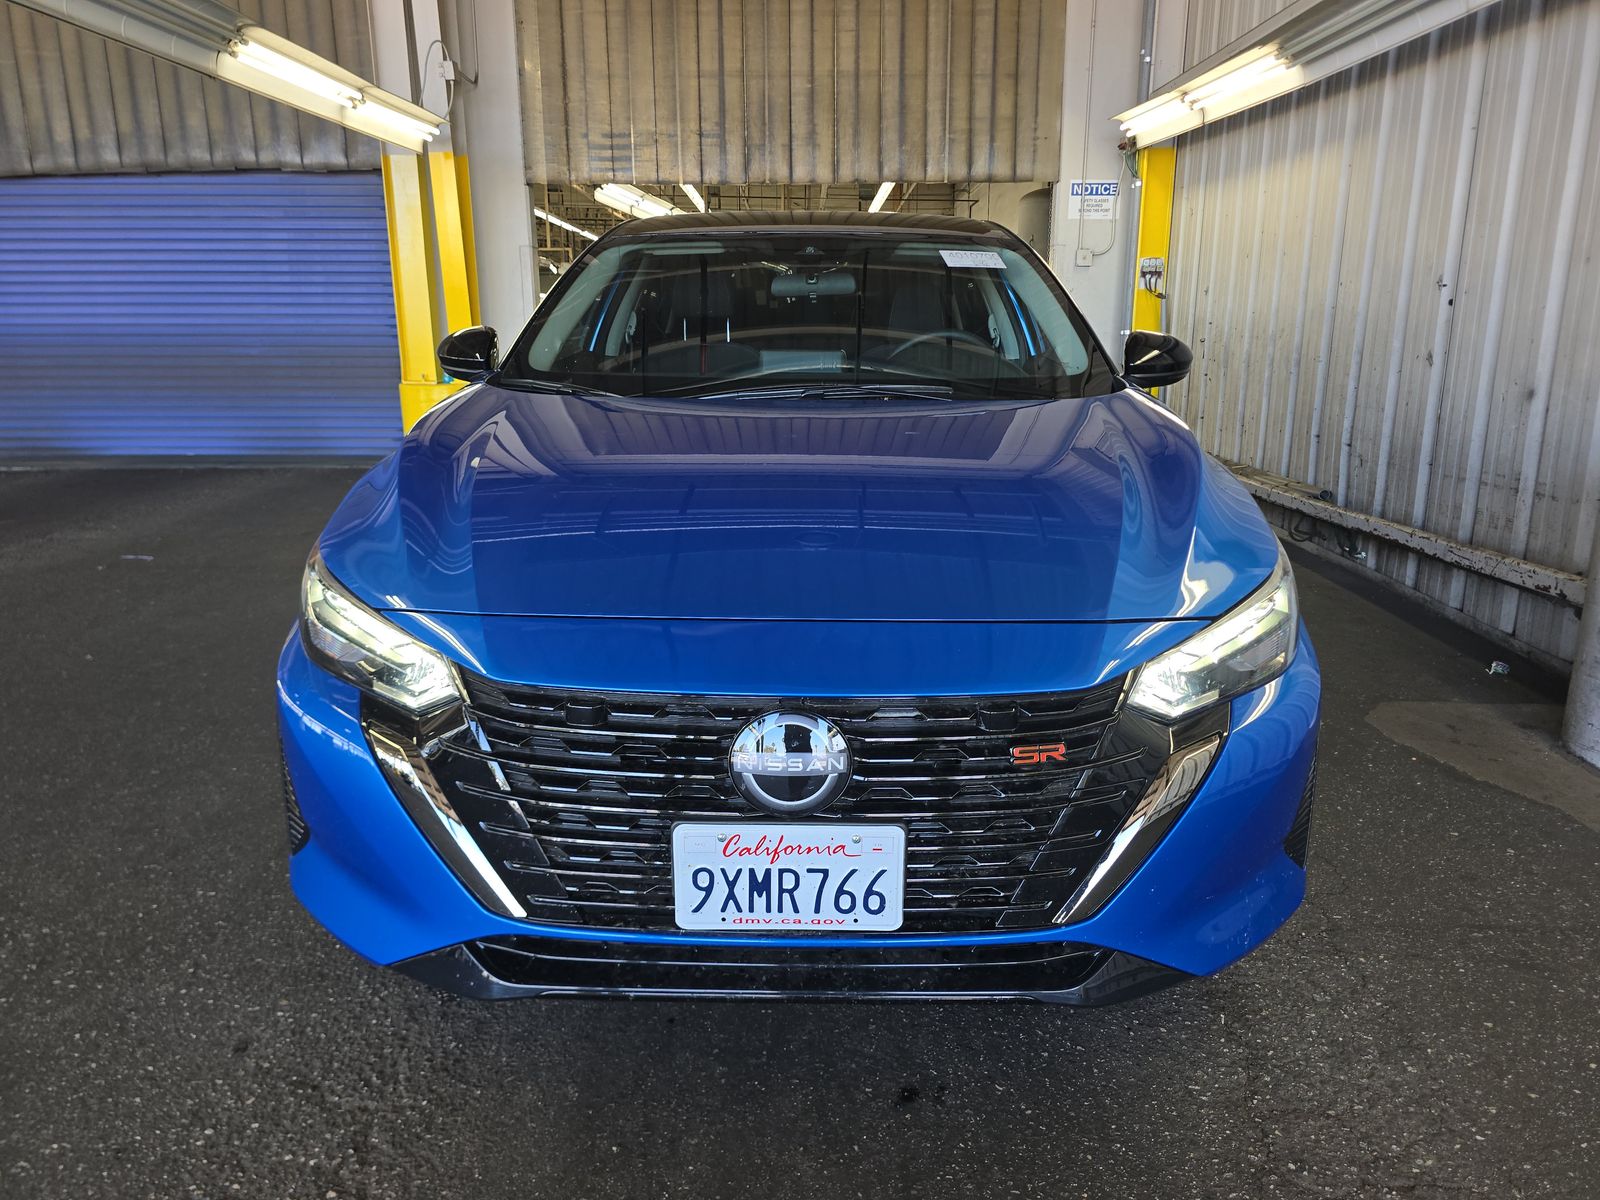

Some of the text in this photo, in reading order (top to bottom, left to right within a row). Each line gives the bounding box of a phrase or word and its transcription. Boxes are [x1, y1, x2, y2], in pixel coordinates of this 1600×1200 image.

[1073, 184, 1118, 195] NOTICE
[737, 755, 844, 772] NISSAN
[1012, 742, 1067, 765] SR
[722, 833, 862, 864] California
[690, 867, 888, 915] 9XMR766
[732, 917, 846, 925] dmv.ca.gov
